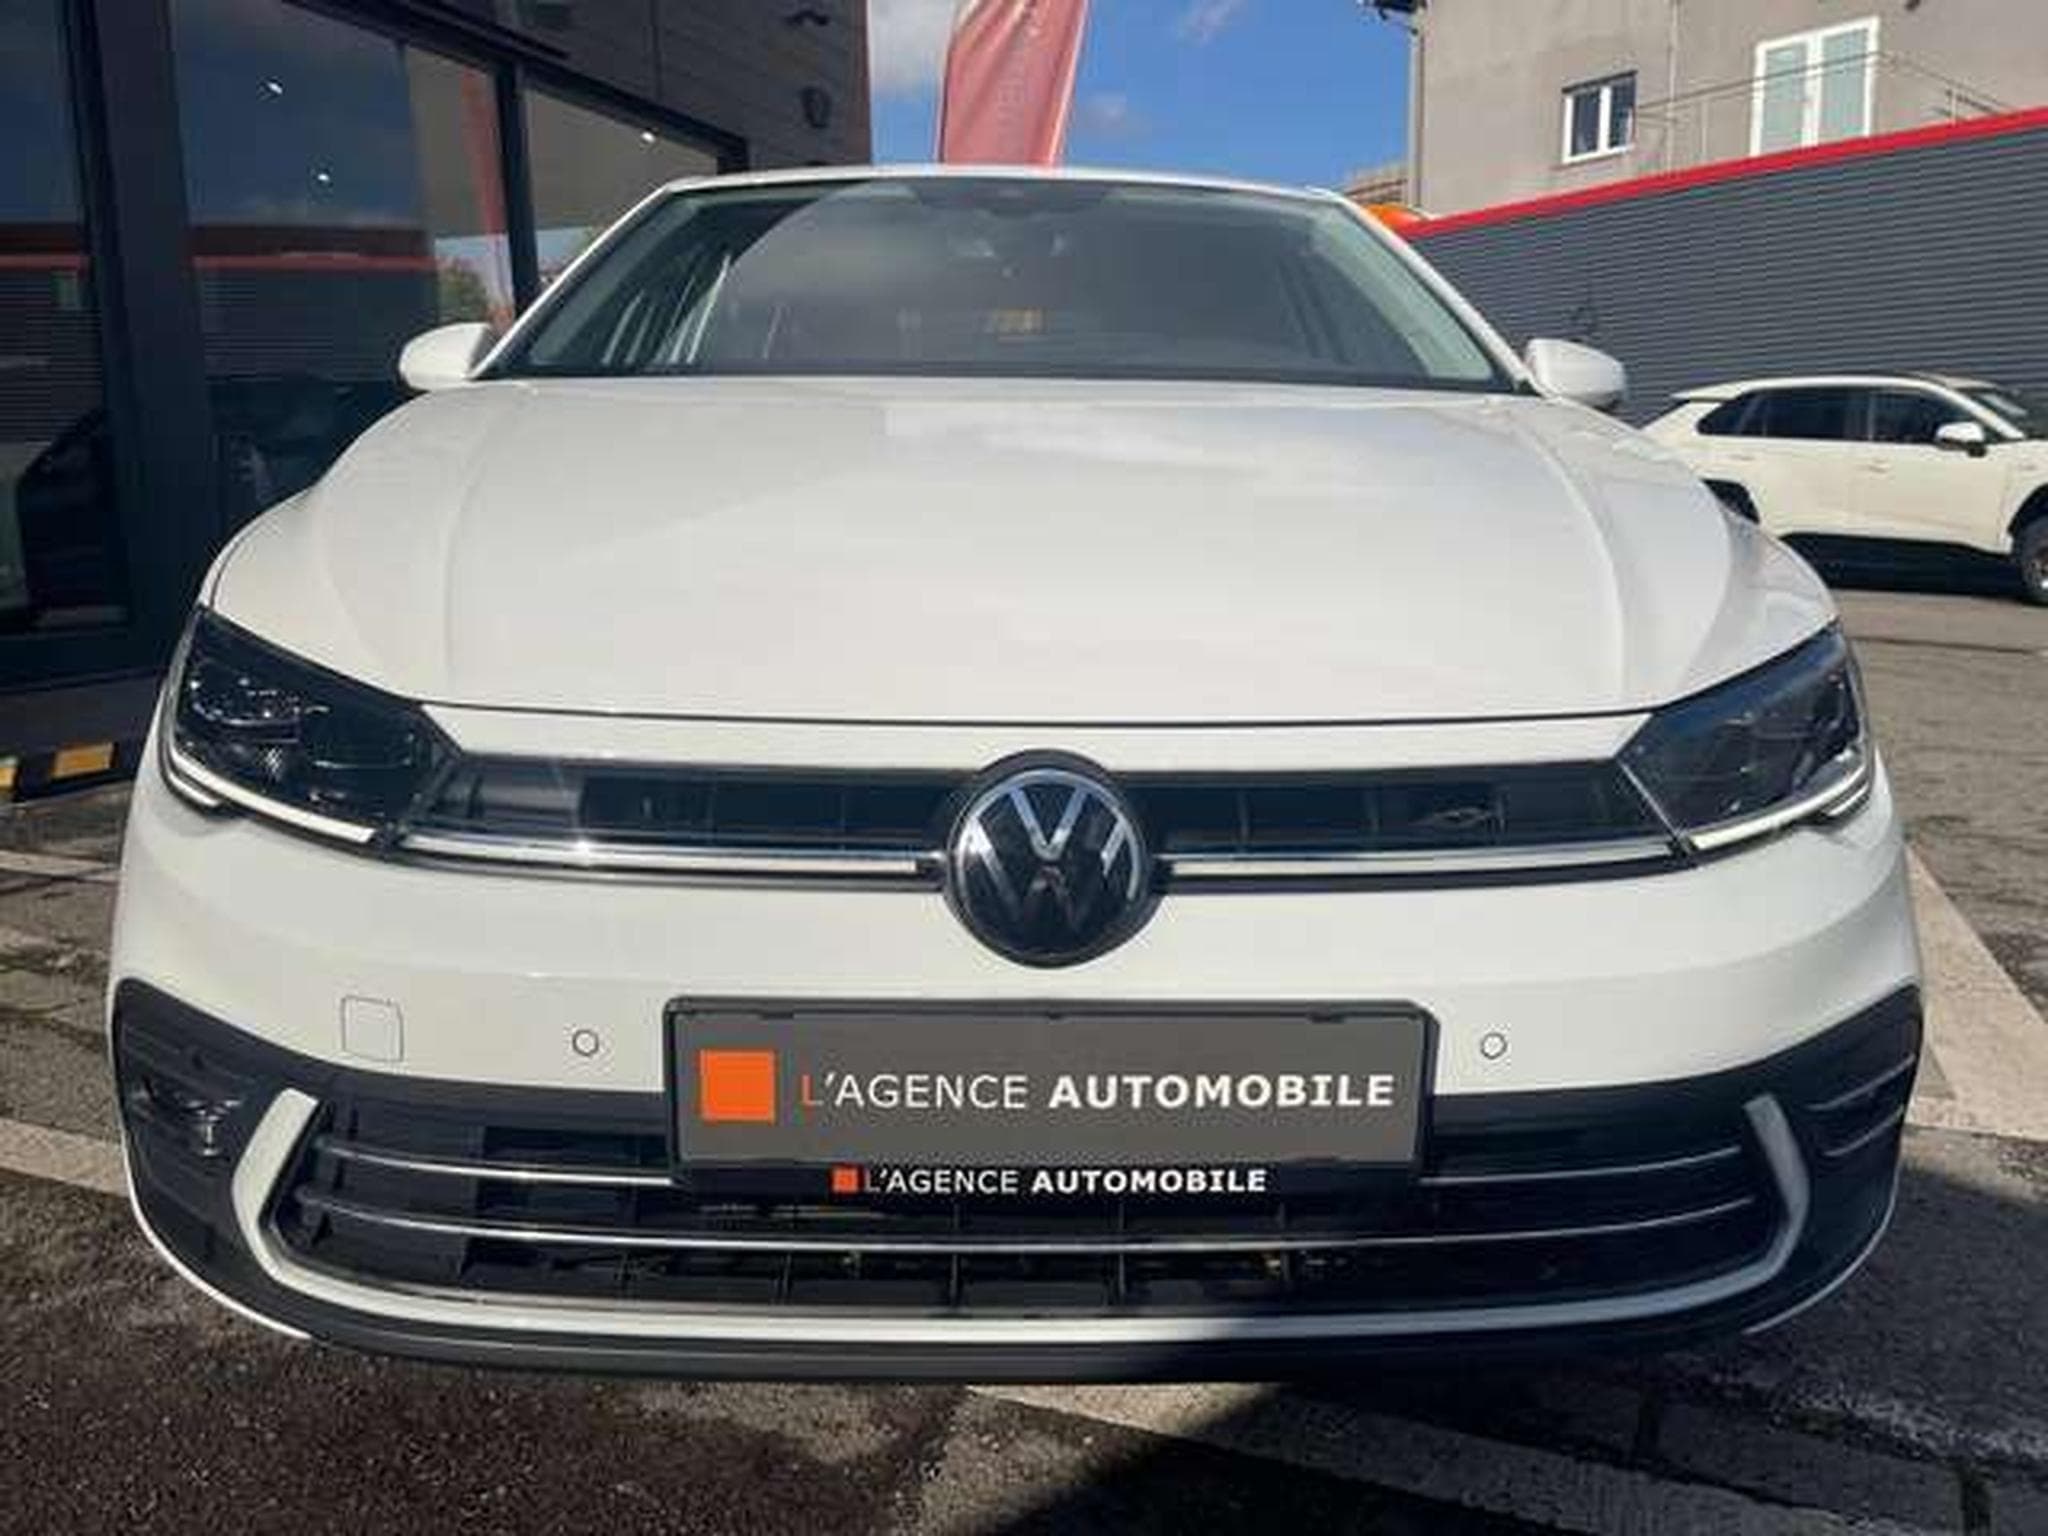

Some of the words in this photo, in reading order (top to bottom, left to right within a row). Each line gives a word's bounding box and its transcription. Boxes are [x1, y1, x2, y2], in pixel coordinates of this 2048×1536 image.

[801, 1071, 1028, 1109] L'AGENCE
[1049, 1073, 1394, 1109] AUTOMOBILE
[864, 1169, 1018, 1194] L'AGENCE
[1031, 1169, 1268, 1193] AUTOMOBILE
